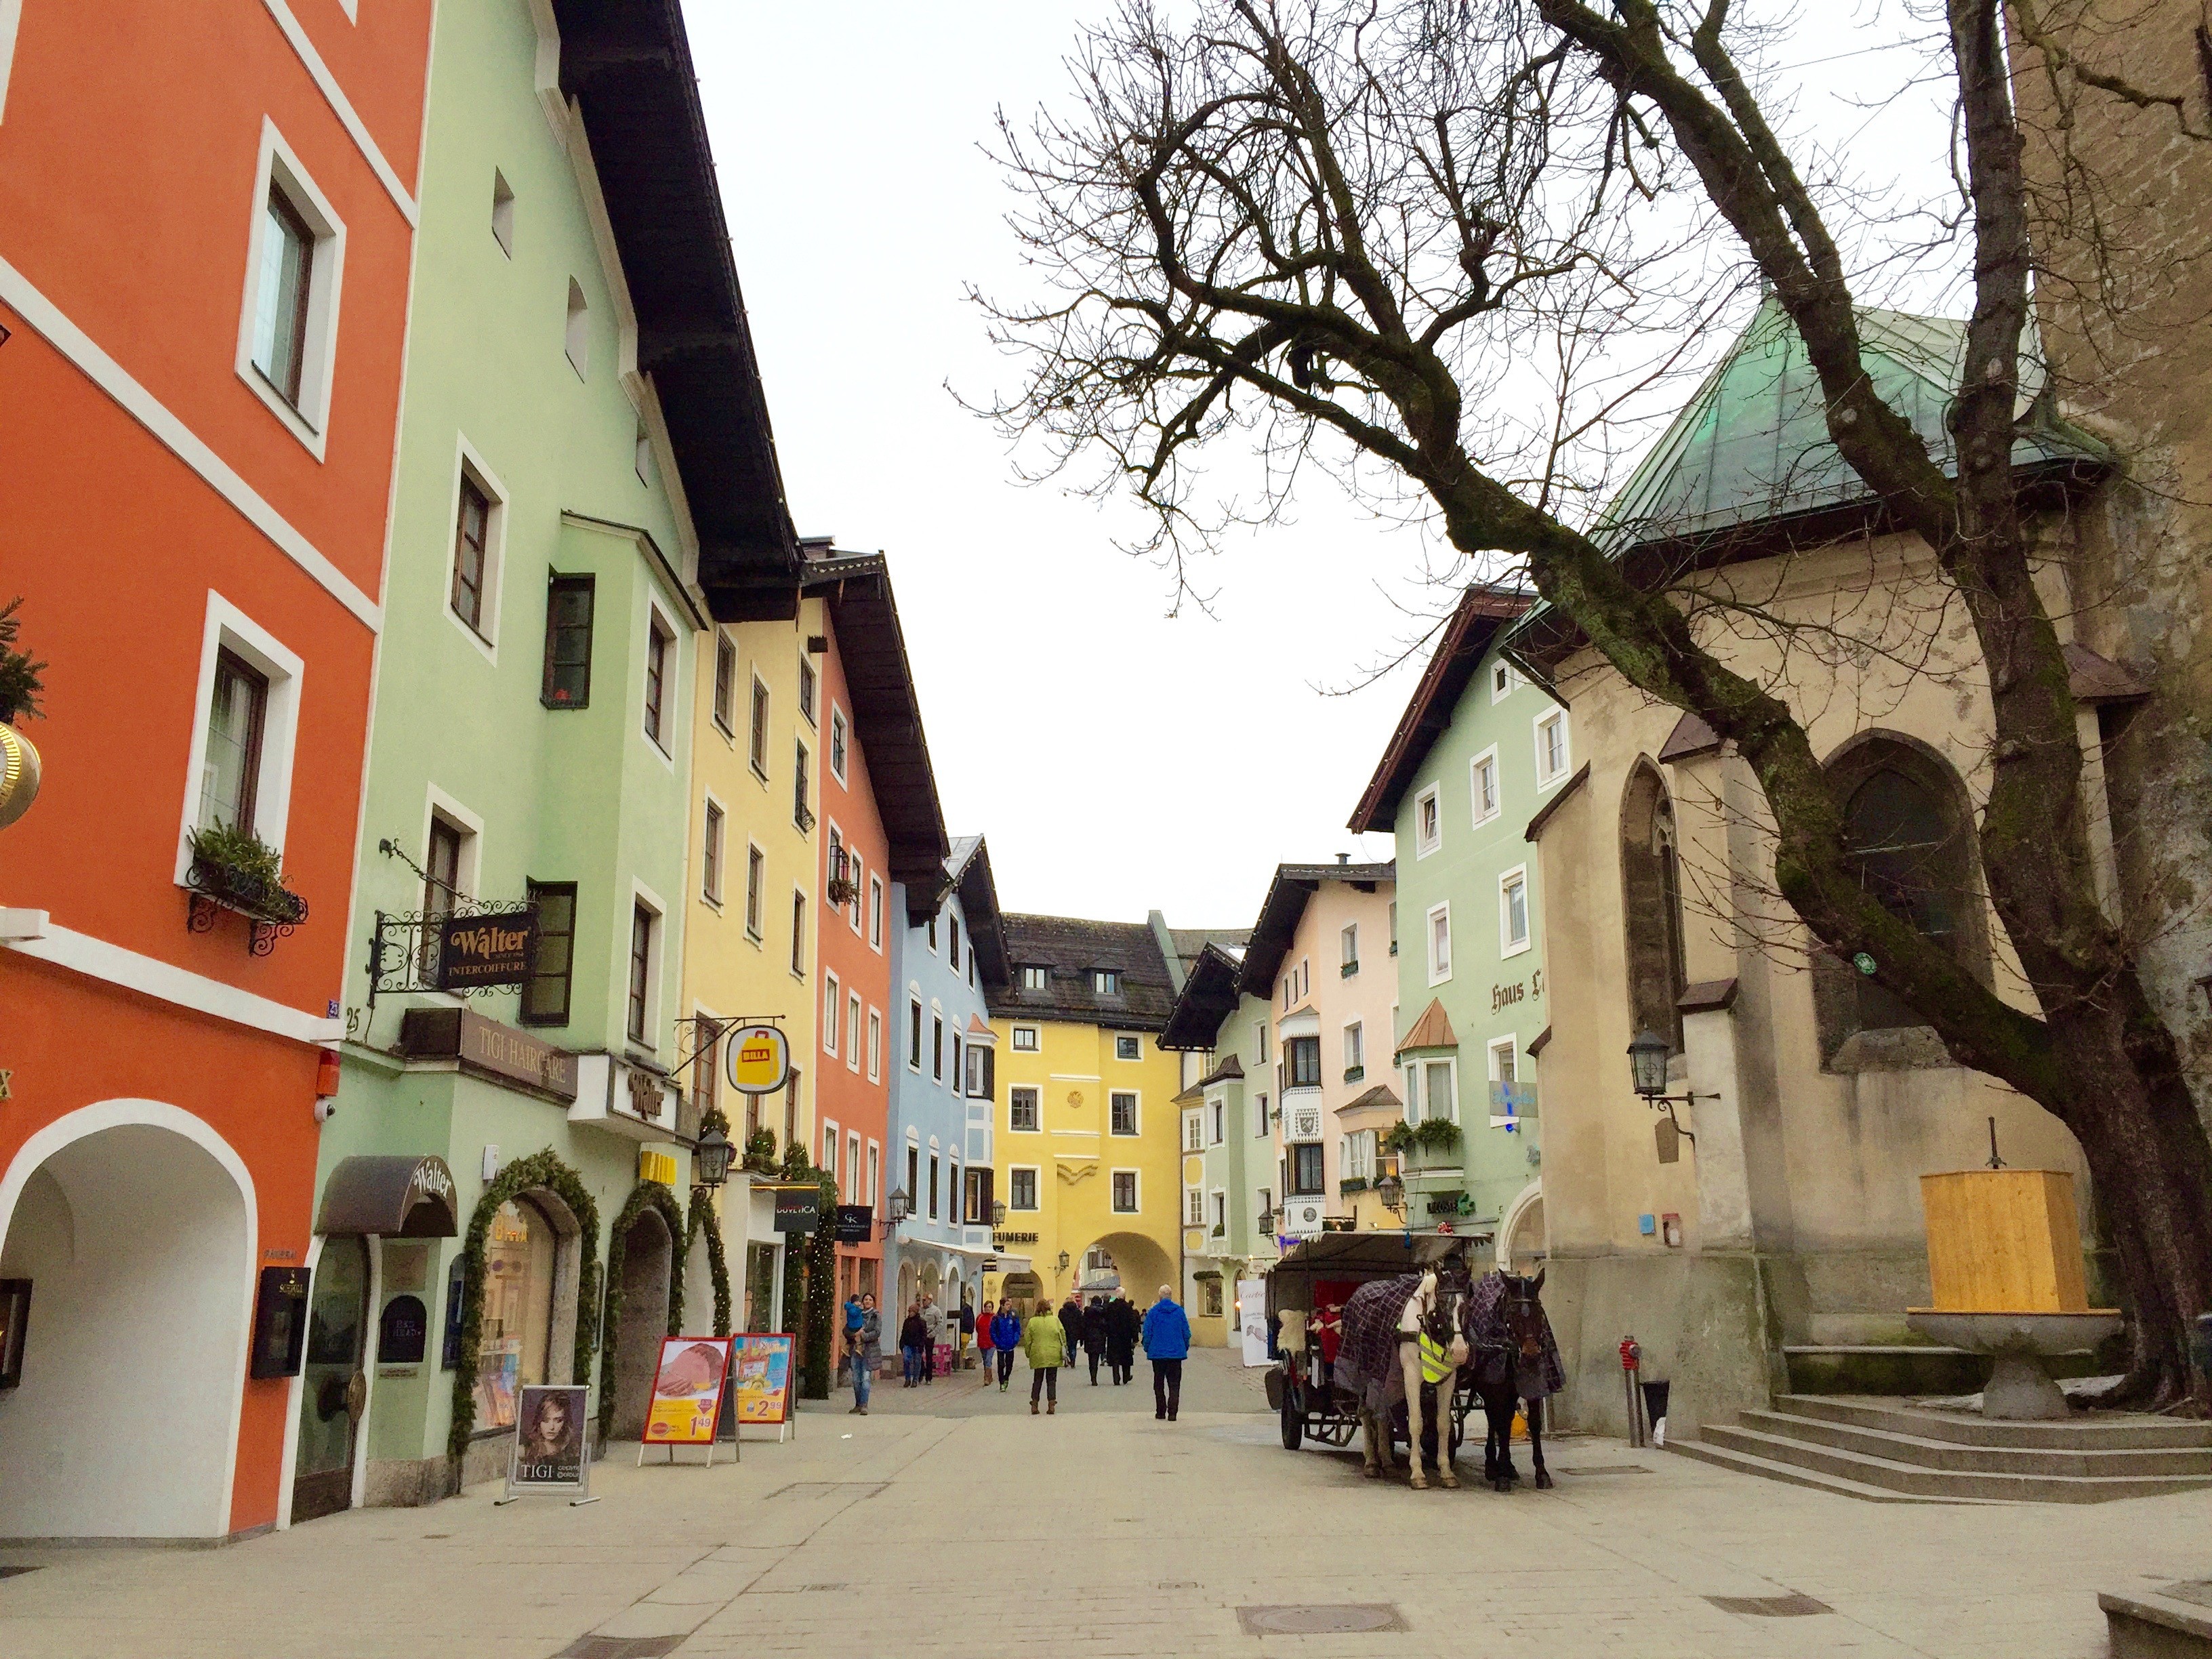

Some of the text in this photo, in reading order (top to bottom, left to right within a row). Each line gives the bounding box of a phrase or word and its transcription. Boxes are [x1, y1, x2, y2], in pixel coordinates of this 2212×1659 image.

[450, 926, 528, 960] Walter
[346, 1006, 361, 1033] 25
[479, 1026, 565, 1083] TIGI HAIRCARE
[743, 1051, 769, 1061] BILLA
[413, 1160, 452, 1198] Walter
[520, 1464, 552, 1478] TIGI
